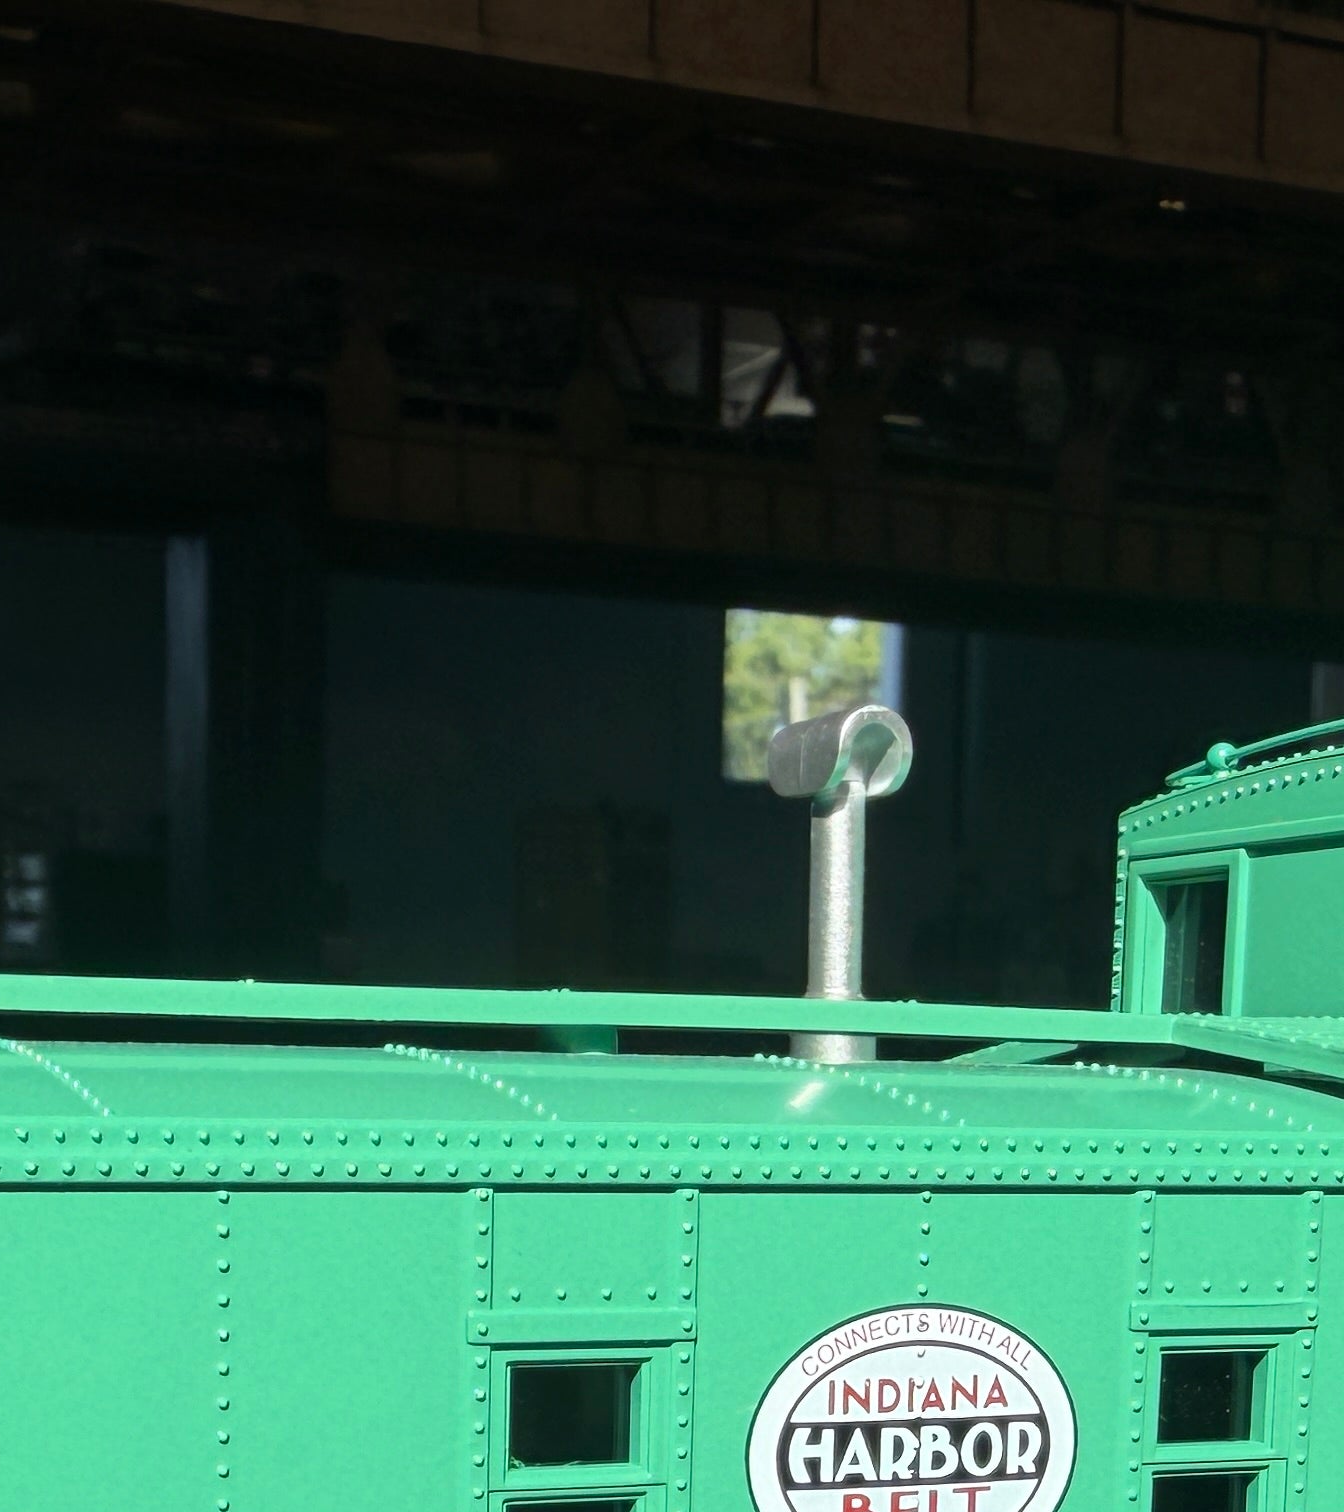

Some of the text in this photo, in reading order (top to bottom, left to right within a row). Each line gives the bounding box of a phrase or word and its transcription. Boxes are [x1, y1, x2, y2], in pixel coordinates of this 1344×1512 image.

[801, 1312, 1034, 1377] CONNECTS WITH ALL
[827, 1373, 1009, 1416] INDIANA
[787, 1421, 1043, 1484] HARBOR
